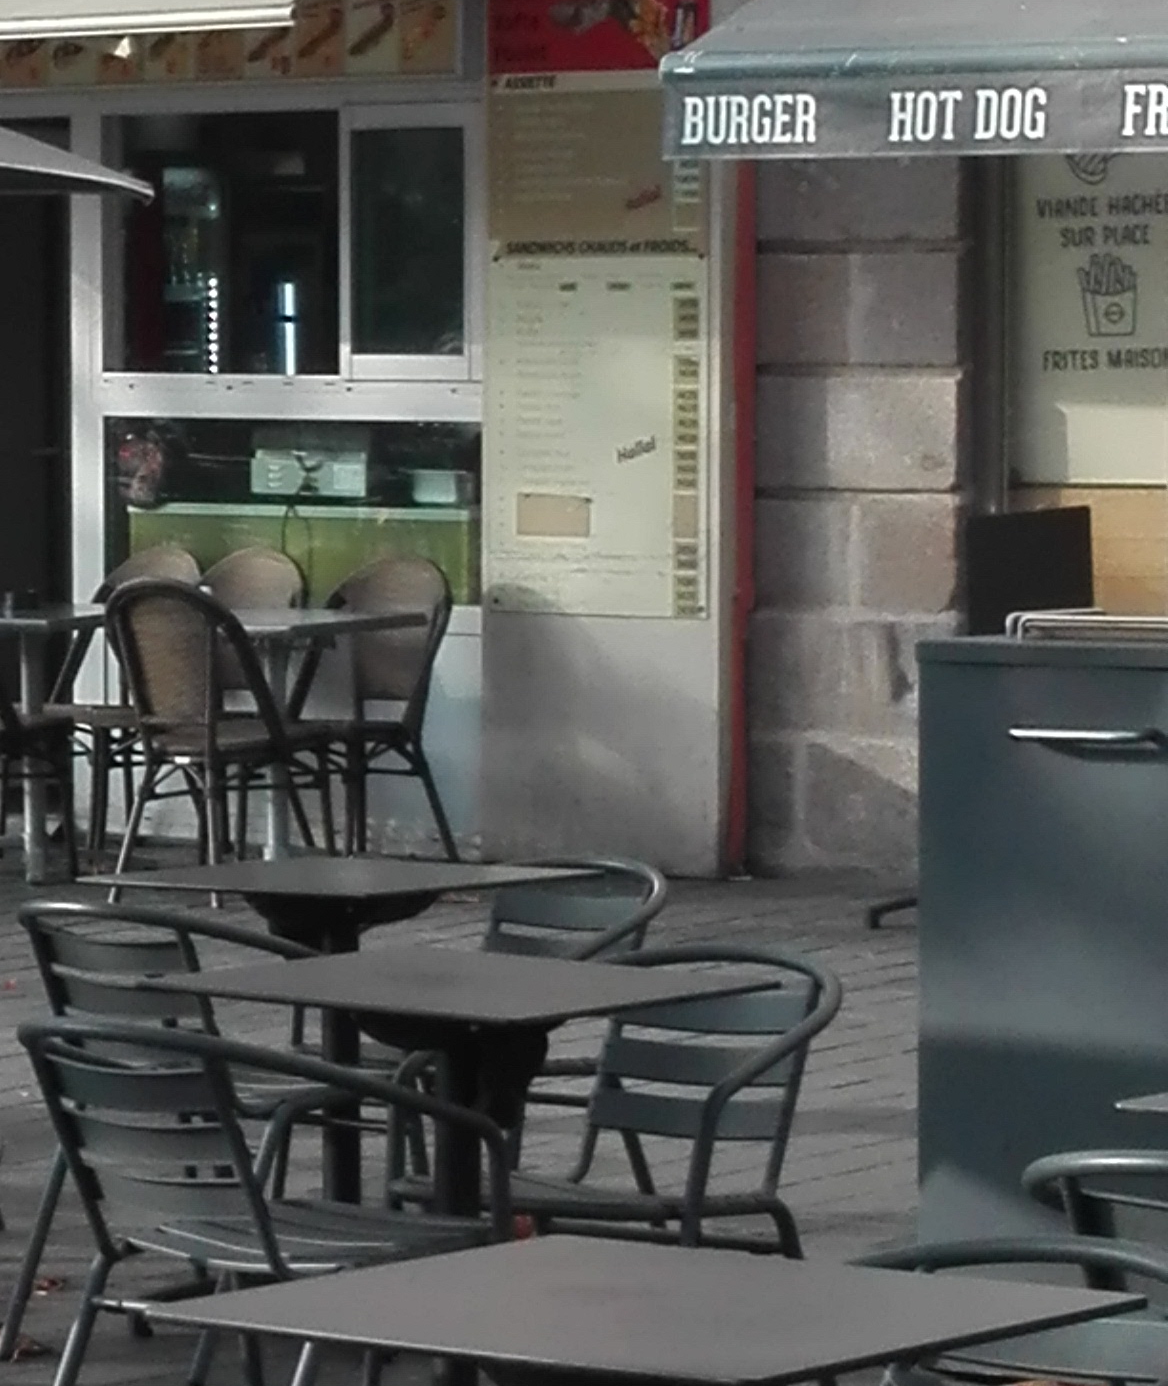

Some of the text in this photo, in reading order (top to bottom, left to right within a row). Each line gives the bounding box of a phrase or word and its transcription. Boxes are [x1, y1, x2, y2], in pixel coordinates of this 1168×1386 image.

[681, 84, 1168, 145] BURGER HOT DOG FR
[1036, 195, 1099, 219] VIANDE
[1059, 223, 1151, 248] SUR PLACE
[1043, 349, 1099, 371] FRITES
